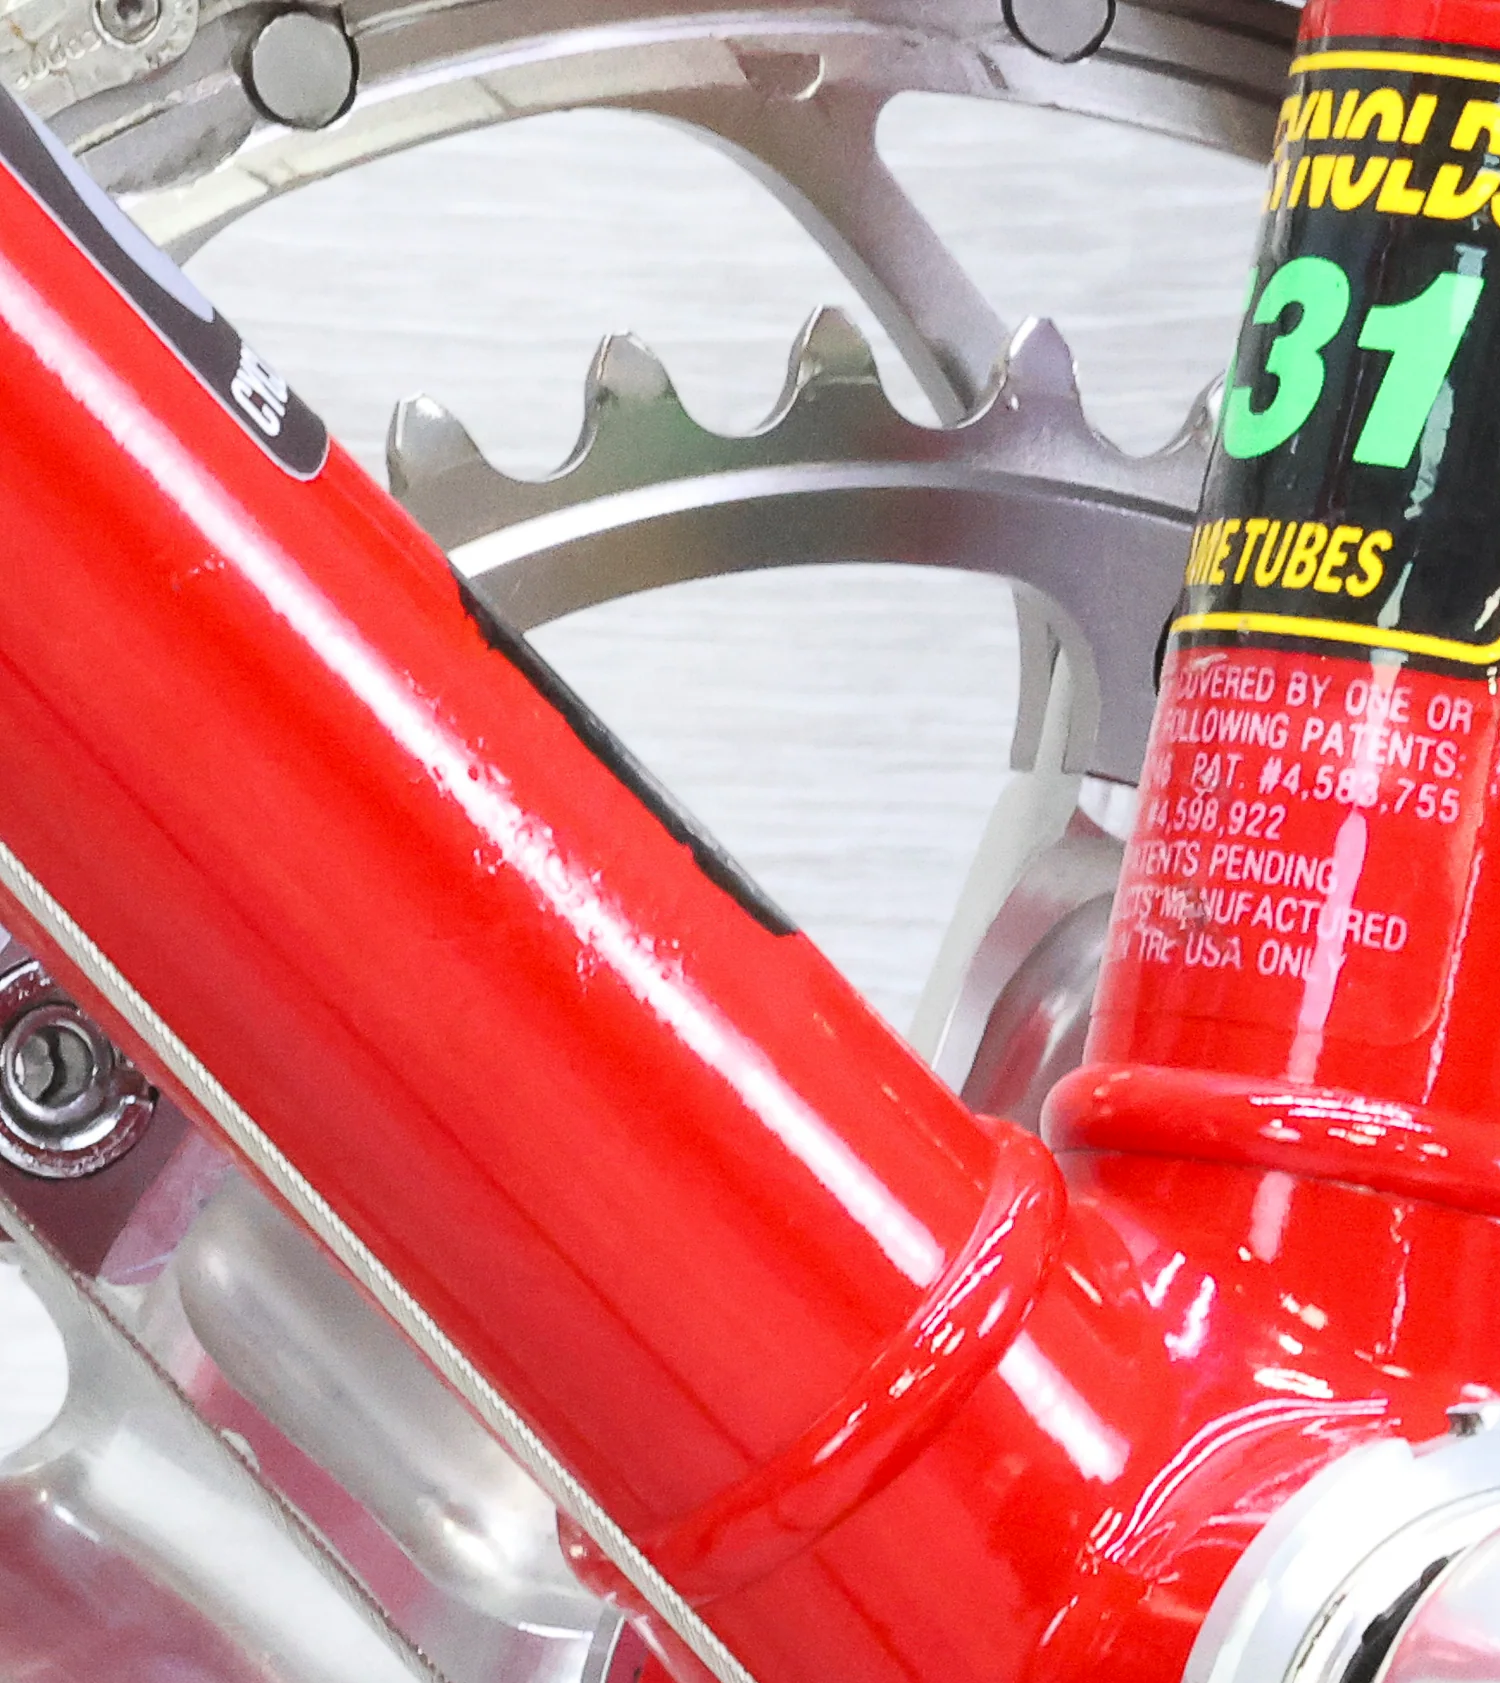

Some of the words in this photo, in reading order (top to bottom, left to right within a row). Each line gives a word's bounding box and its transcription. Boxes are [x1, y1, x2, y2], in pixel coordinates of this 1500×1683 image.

[1223, 257, 1485, 468] 31
[1168, 664, 1276, 702] OVERED
[1286, 671, 1332, 708] BY
[1345, 679, 1412, 723] ONE
[1427, 694, 1473, 734] OR
[1302, 717, 1467, 781] PATENTS:
[1190, 752, 1245, 788] PAT.
[1258, 756, 1460, 824] #4,583,755
[1209, 844, 1338, 896] PENDING
[1185, 931, 1242, 971] USA
